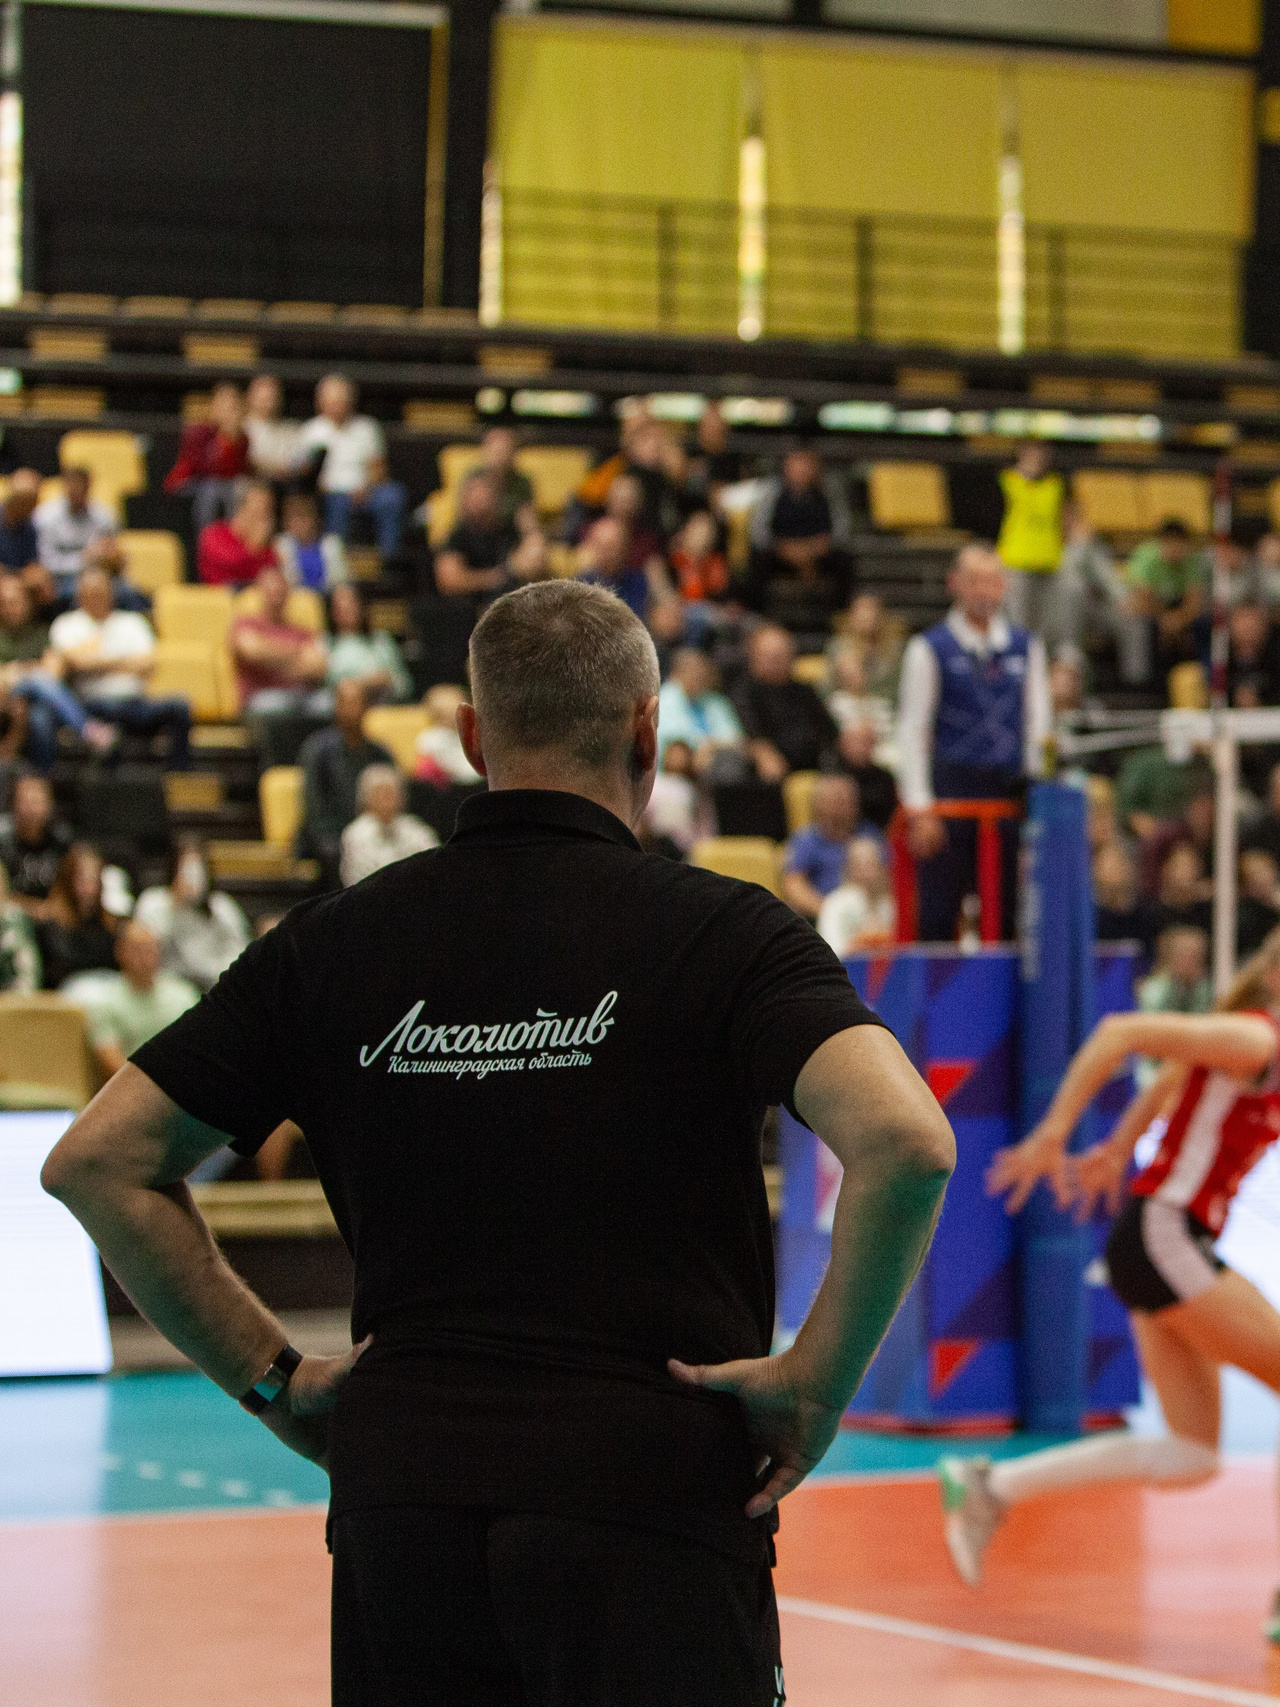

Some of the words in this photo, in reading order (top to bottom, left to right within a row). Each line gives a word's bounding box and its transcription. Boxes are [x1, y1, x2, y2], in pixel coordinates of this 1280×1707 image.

[359, 990, 618, 1067] Локомотив
[387, 1055, 526, 1080] Калининградская
[527, 1050, 593, 1070] область
